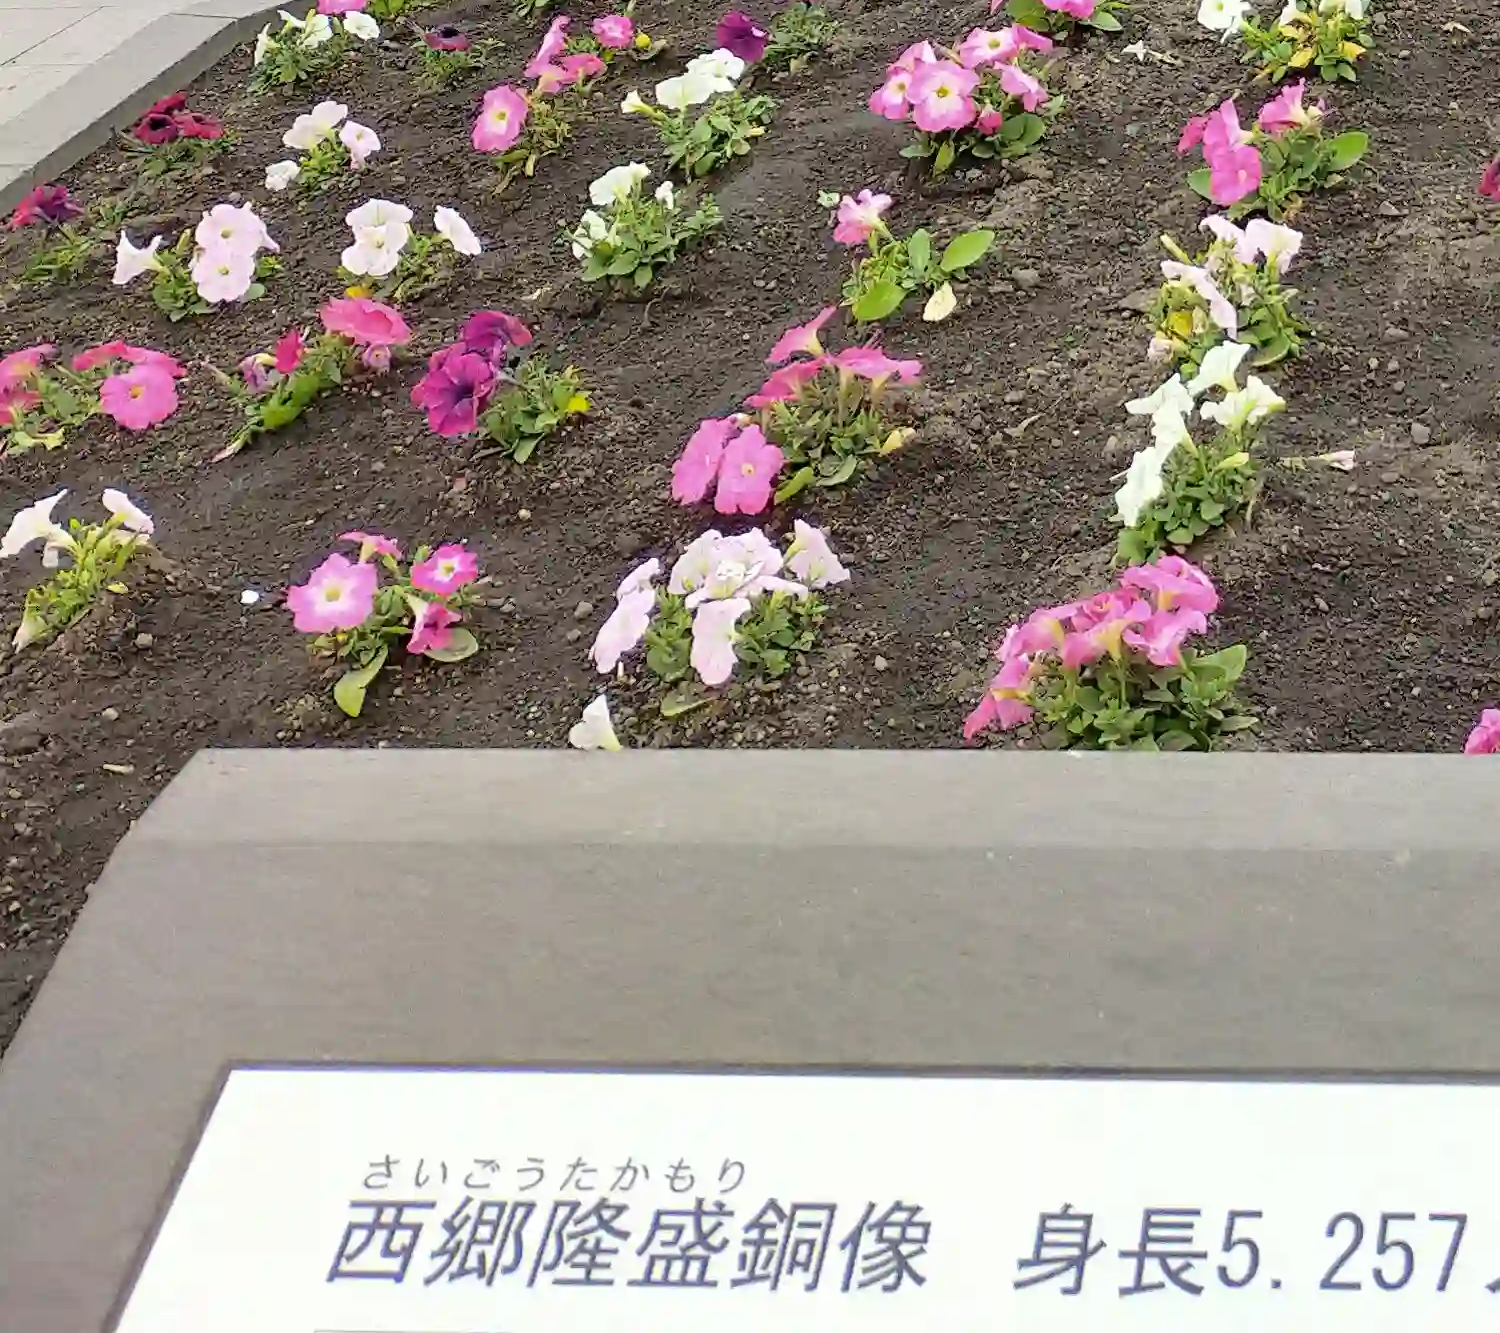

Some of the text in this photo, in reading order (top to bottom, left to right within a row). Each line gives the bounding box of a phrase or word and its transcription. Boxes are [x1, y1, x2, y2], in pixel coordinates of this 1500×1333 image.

[361, 1154, 748, 1194] さいごうたかもり
[326, 1196, 932, 1293] 西郷隆盛銅像
